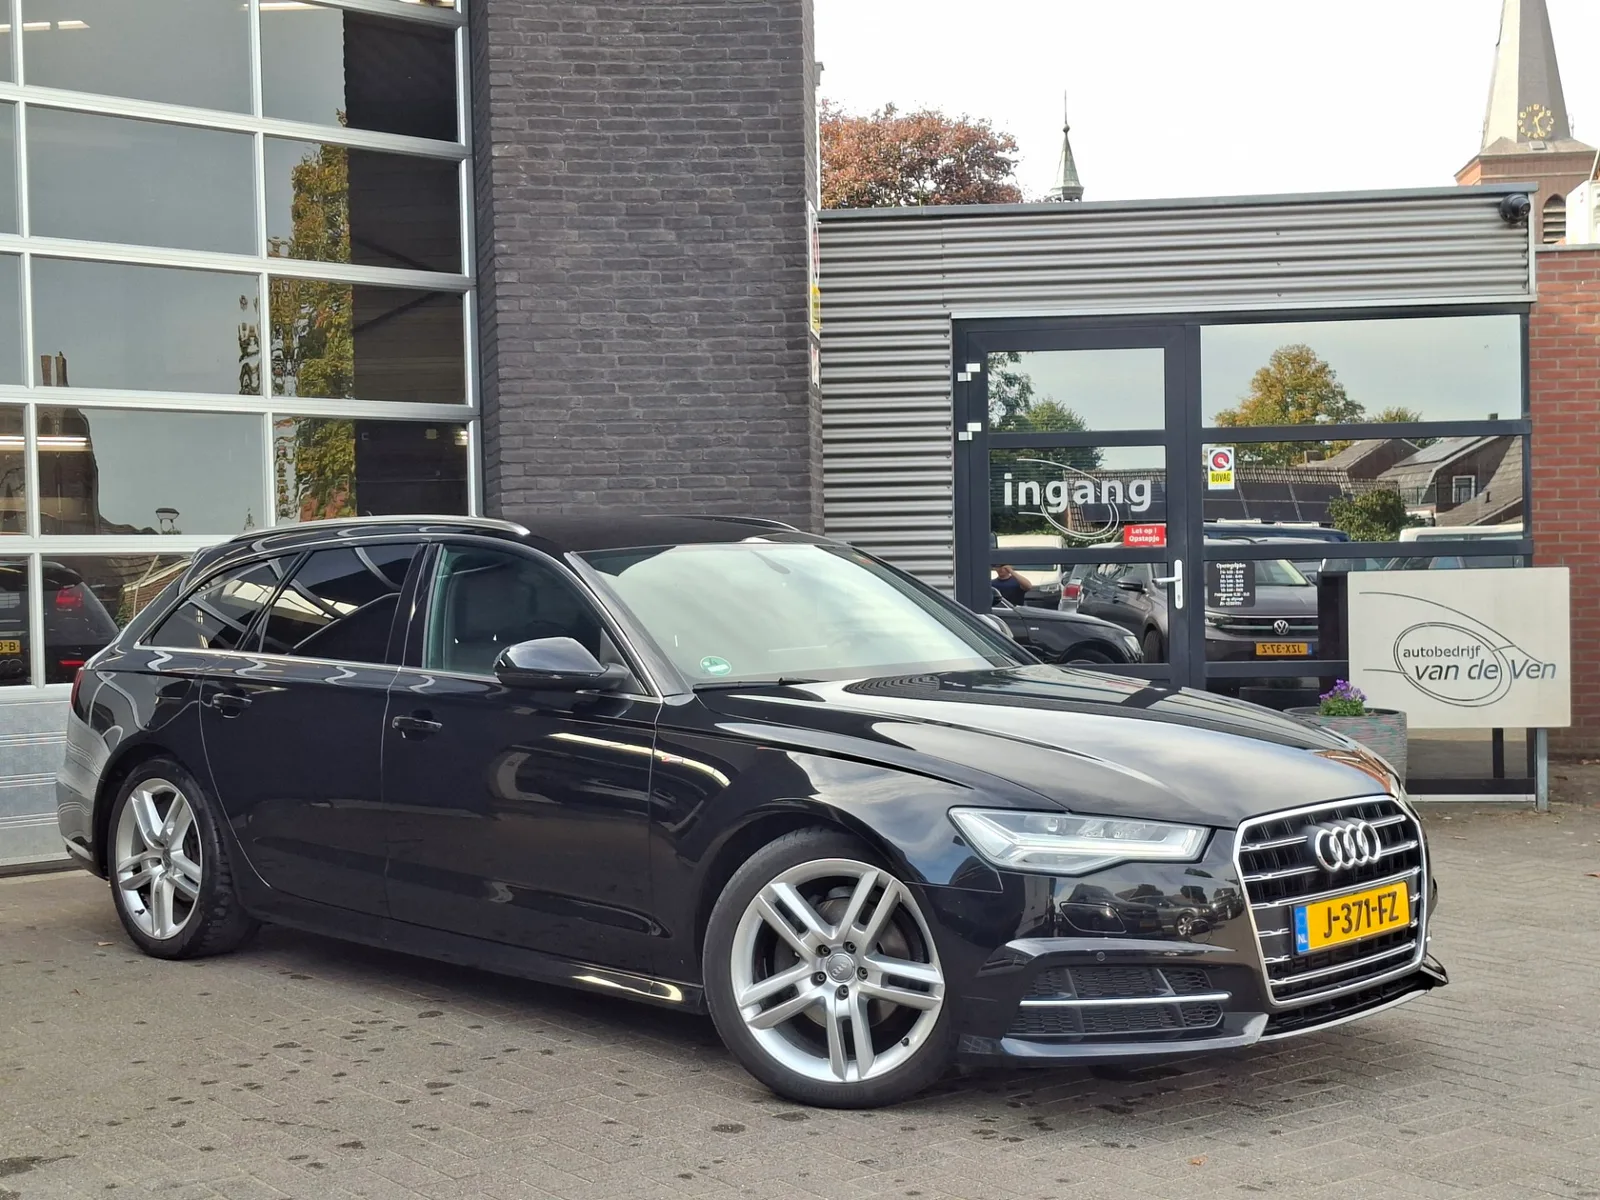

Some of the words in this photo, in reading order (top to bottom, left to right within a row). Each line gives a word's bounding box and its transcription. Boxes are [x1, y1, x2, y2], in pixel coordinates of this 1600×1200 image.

[1004, 473, 1151, 513] ingang
[1403, 645, 1480, 659] autobedrijf
[1415, 664, 1459, 680] van
[1467, 658, 1498, 680] de
[1511, 658, 1557, 680] Ven
[1323, 891, 1399, 938] J-371-FZ
[1297, 934, 1307, 944] NL
